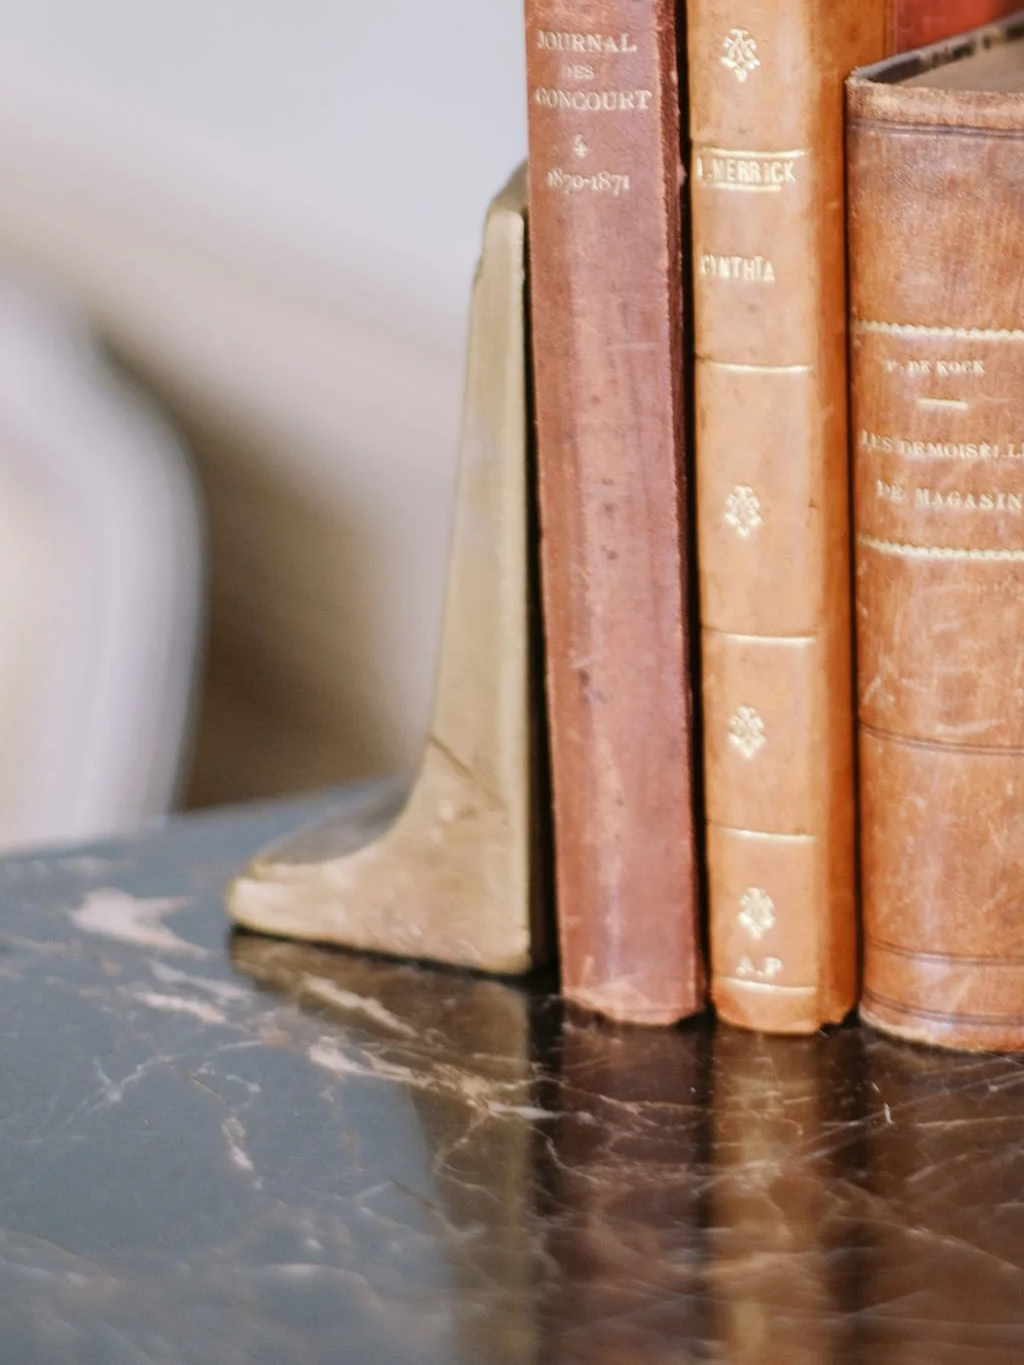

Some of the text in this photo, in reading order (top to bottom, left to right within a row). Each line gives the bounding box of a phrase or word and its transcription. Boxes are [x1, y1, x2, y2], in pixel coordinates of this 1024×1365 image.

[537, 31, 637, 53] JOURNAL
[562, 64, 595, 80] DES
[534, 87, 652, 112] GONCOURT
[573, 135, 588, 158] 4
[907, 359, 931, 376] DE
[861, 429, 893, 452] LES
[876, 479, 1023, 511] DE MAGASIN
